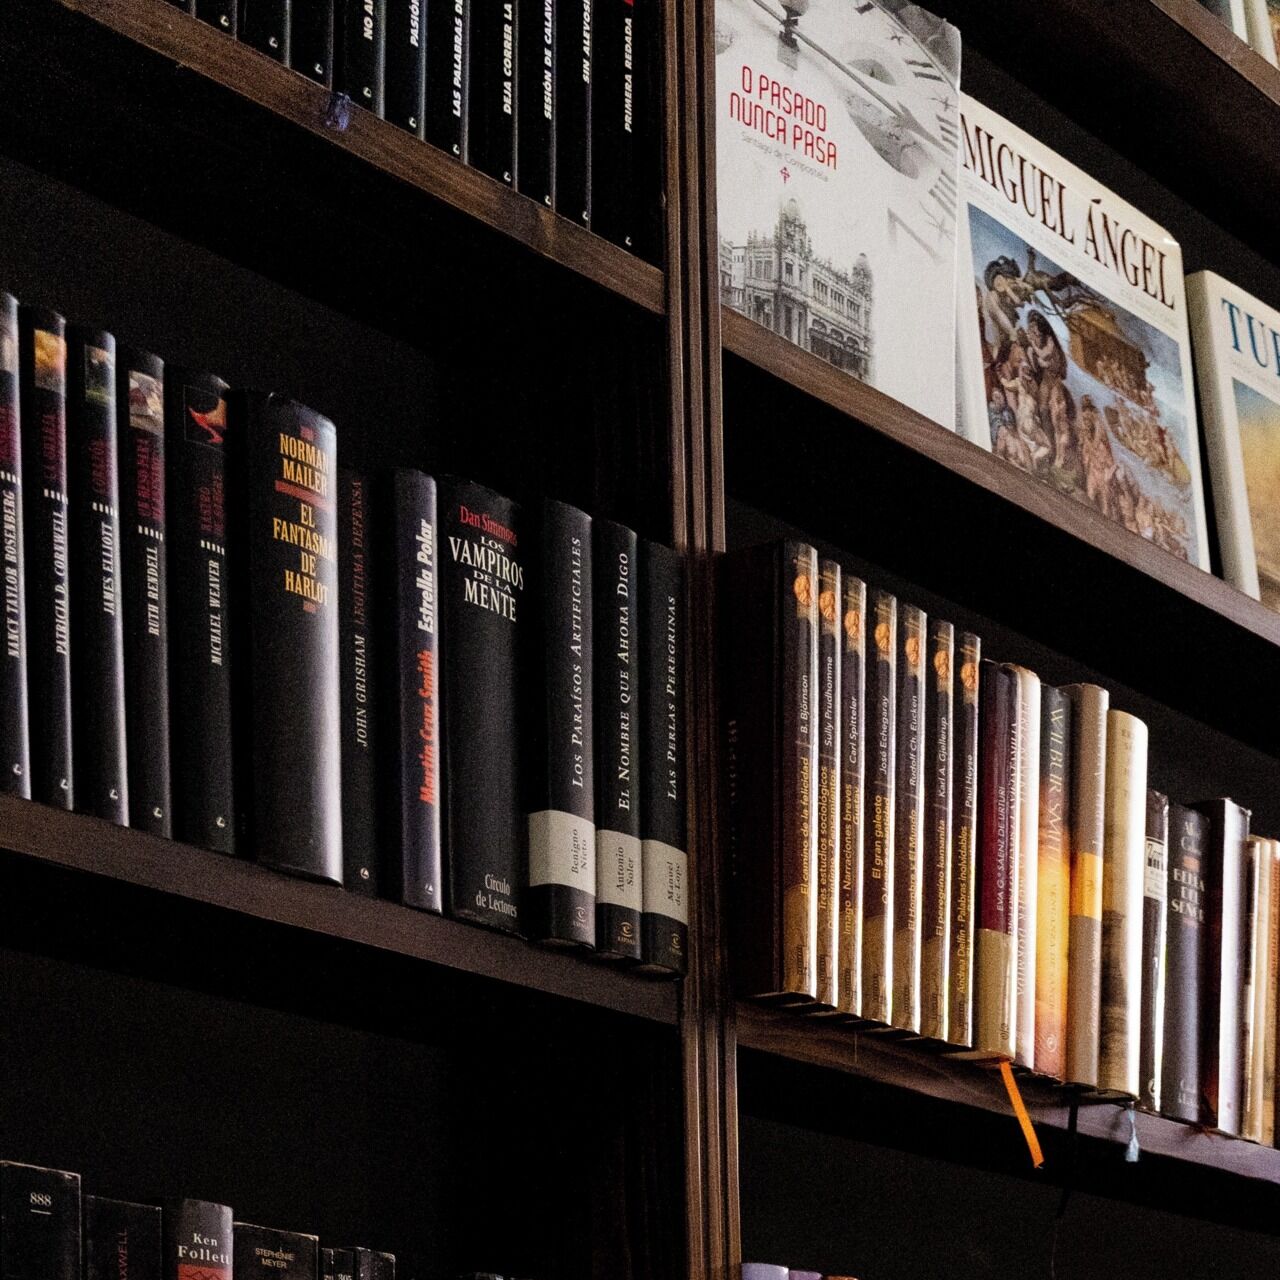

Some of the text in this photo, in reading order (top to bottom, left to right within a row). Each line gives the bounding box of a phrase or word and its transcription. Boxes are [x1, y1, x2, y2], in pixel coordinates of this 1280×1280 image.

[503, 3, 512, 115] DEJA CORRER LA
[582, 58, 590, 84] SIN
[624, 18, 632, 133] PRIMERA REDADA
[741, 66, 826, 131] O PASADO
[730, 92, 838, 171] NUNCA PASA
[960, 113, 1176, 310] MIGUEL ÁNGEL
[280, 432, 330, 473] NORMAN
[282, 457, 328, 498] MAILER
[301, 504, 316, 528] EL
[458, 504, 480, 526] Dan
[301, 551, 316, 578] DE
[449, 537, 524, 591] VAMPIROS
[480, 535, 504, 553] LOS
[147, 547, 159, 636] RUTH RENDELL
[284, 570, 329, 606] HARLOT
[416, 518, 434, 635] Estrella Polar
[208, 559, 222, 666] MICHAEL WEAVER
[464, 578, 518, 624] MENTE
[354, 633, 368, 748] JOHN GRISHAM
[849, 741, 857, 764] Carl
[1049, 707, 1063, 792] WILBUR
[484, 873, 511, 897] Círculo
[30, 1192, 52, 1207] 888
[177, 1245, 230, 1266] Follett
[192, 1232, 218, 1246] Ken
